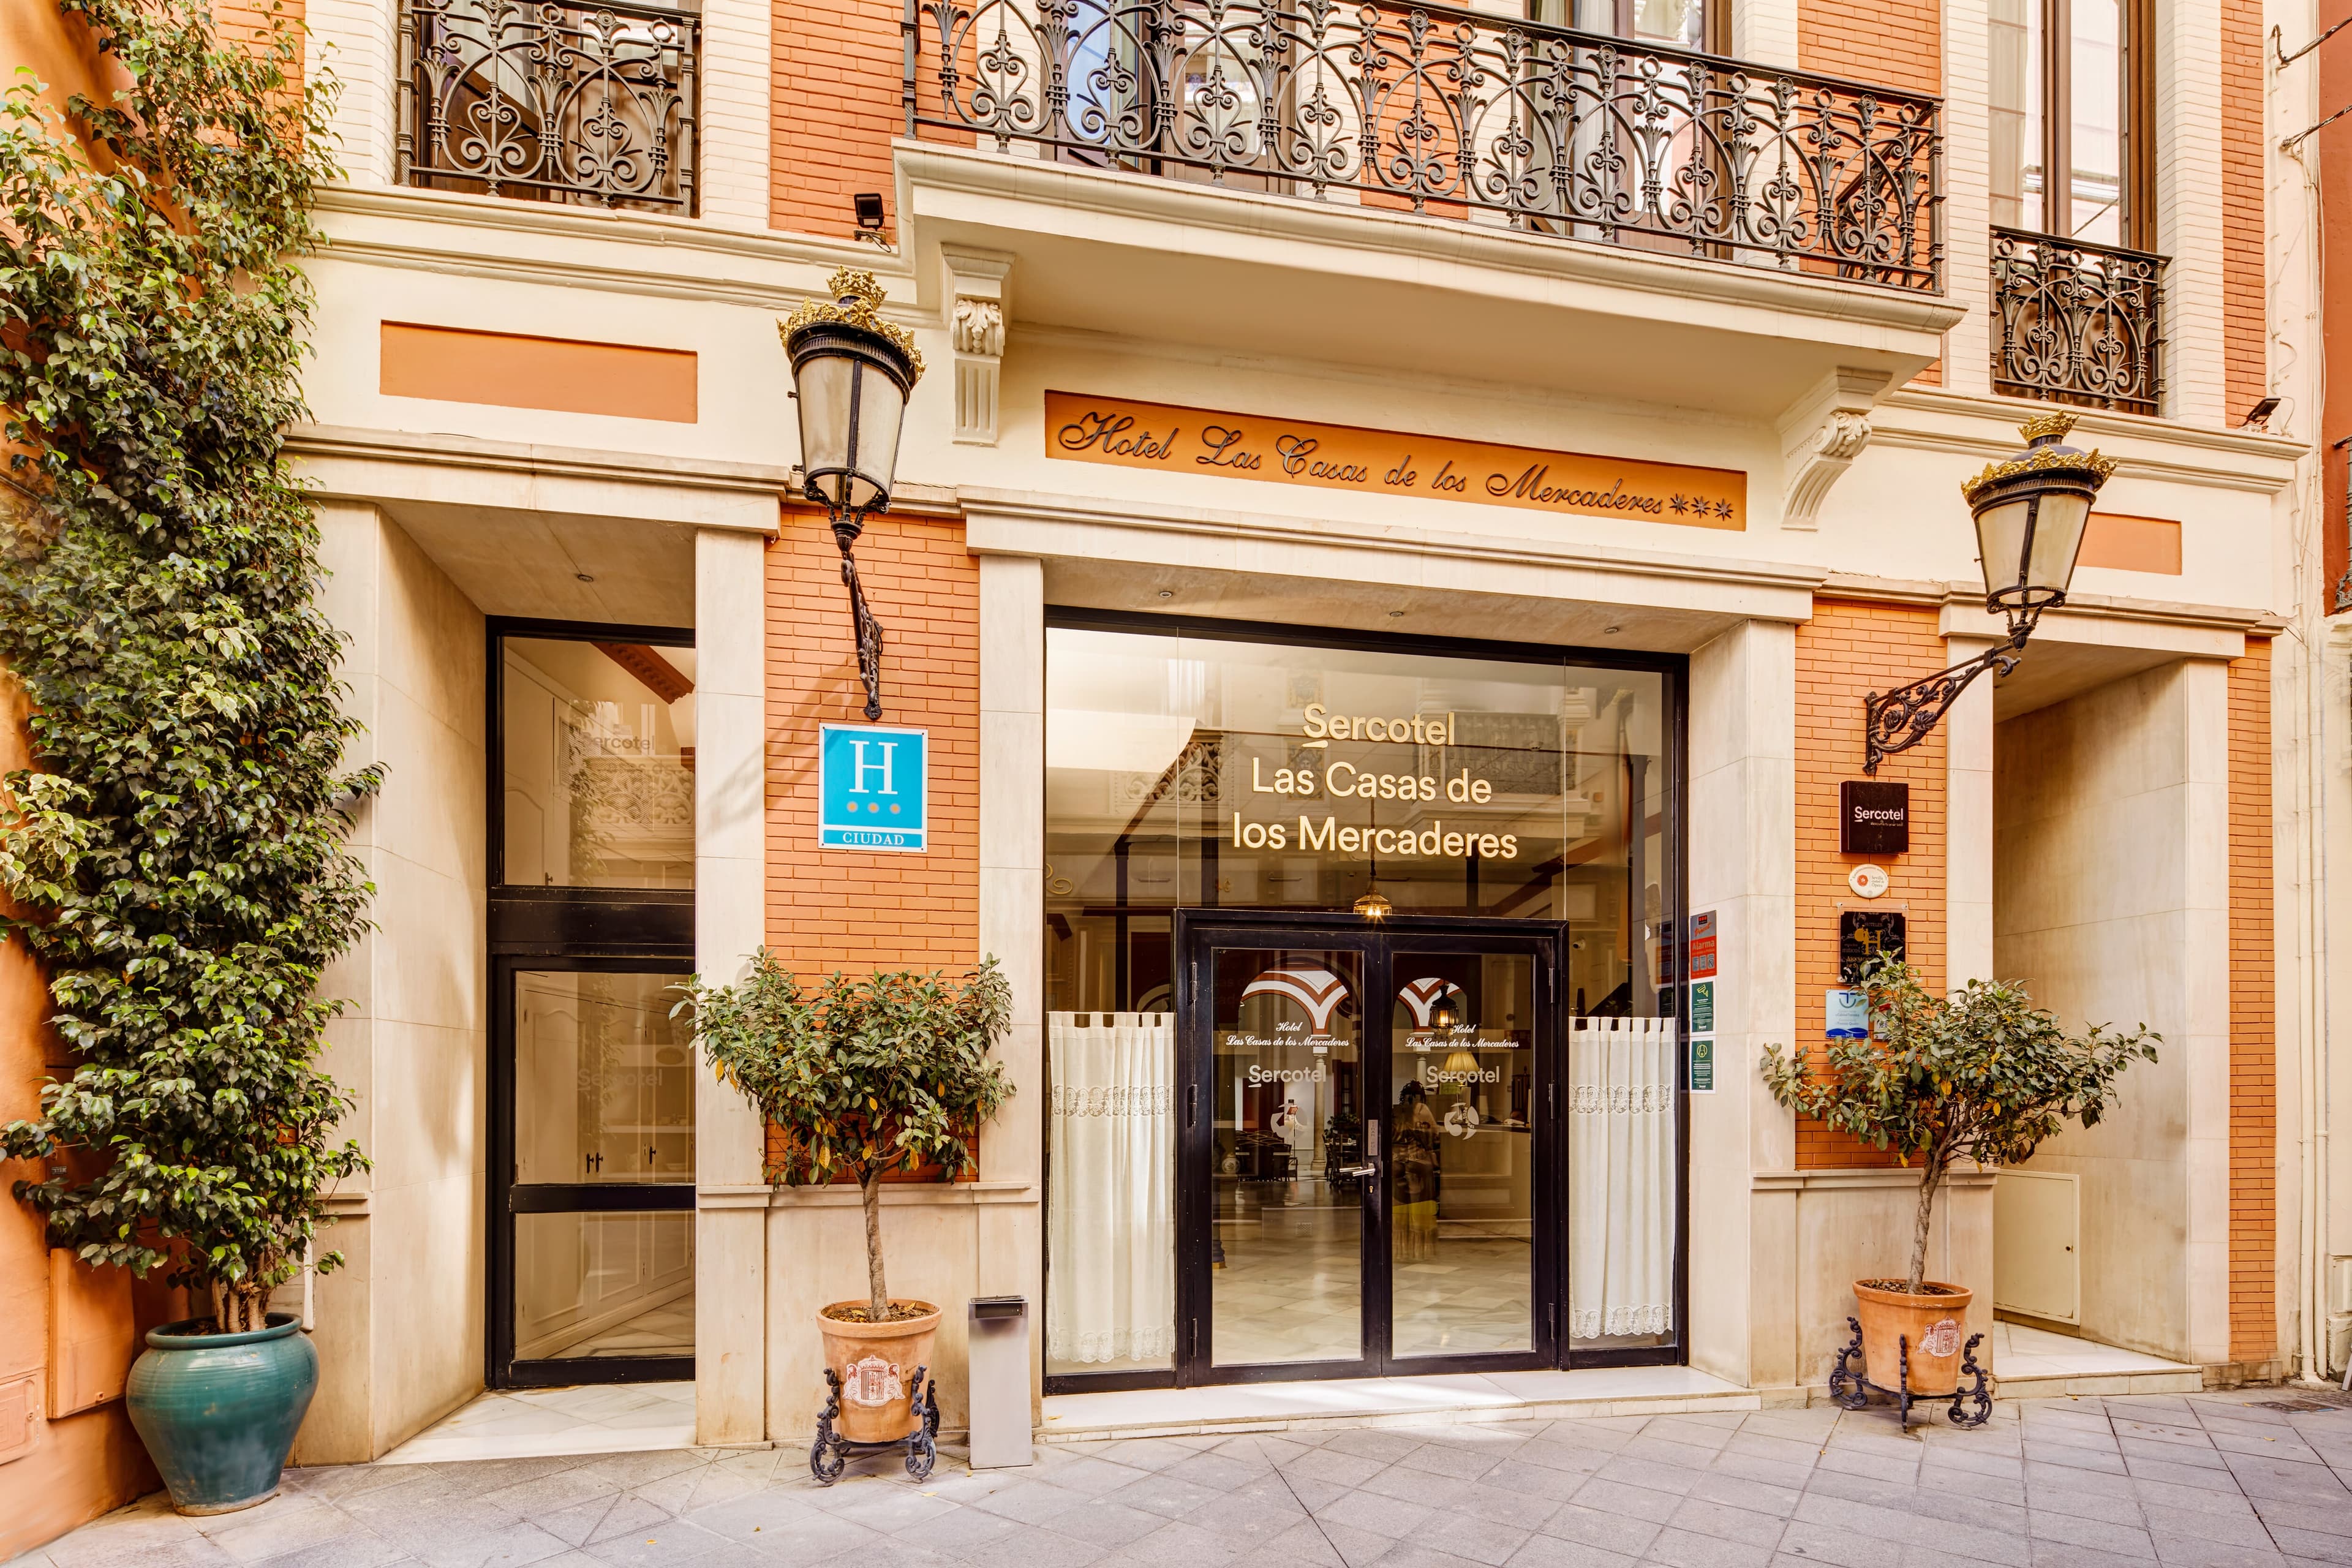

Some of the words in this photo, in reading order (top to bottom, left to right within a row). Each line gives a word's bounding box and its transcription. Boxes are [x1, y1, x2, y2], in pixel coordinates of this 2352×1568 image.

[1058, 412, 1180, 460] Hotel
[1196, 425, 1261, 470] Las
[1276, 435, 1367, 482] Casas
[1384, 454, 1417, 487] de
[1431, 460, 1467, 492] los
[1485, 464, 1664, 514] Mercaderes
[1302, 703, 1455, 748] Sercotel
[848, 740, 899, 795] H
[1252, 757, 1314, 795] Las
[1325, 761, 1437, 802] Casas
[1447, 768, 1493, 804] de
[1854, 806, 1904, 822] Sercotel
[842, 832, 905, 845] CIUDAD
[1234, 812, 1287, 850] los
[1298, 815, 1518, 859] Mercaderes
[1692, 940, 1715, 951] Alarma
[1276, 1021, 1303, 1031] Hotel
[1451, 1023, 1476, 1033] Hotel
[1226, 1035, 1244, 1046] Las
[1245, 1035, 1272, 1046] Casas
[1273, 1036, 1284, 1046] de
[1286, 1036, 1297, 1046] los
[1298, 1036, 1349, 1046] Mercaderes
[1405, 1037, 1422, 1047] Las
[1423, 1037, 1447, 1047] Casas
[1449, 1039, 1459, 1047] de
[1460, 1038, 1470, 1047] los
[1472, 1038, 1519, 1048] Mercaderes
[1248, 1065, 1327, 1088] Sercotel
[1425, 1065, 1500, 1087] Sercotel
